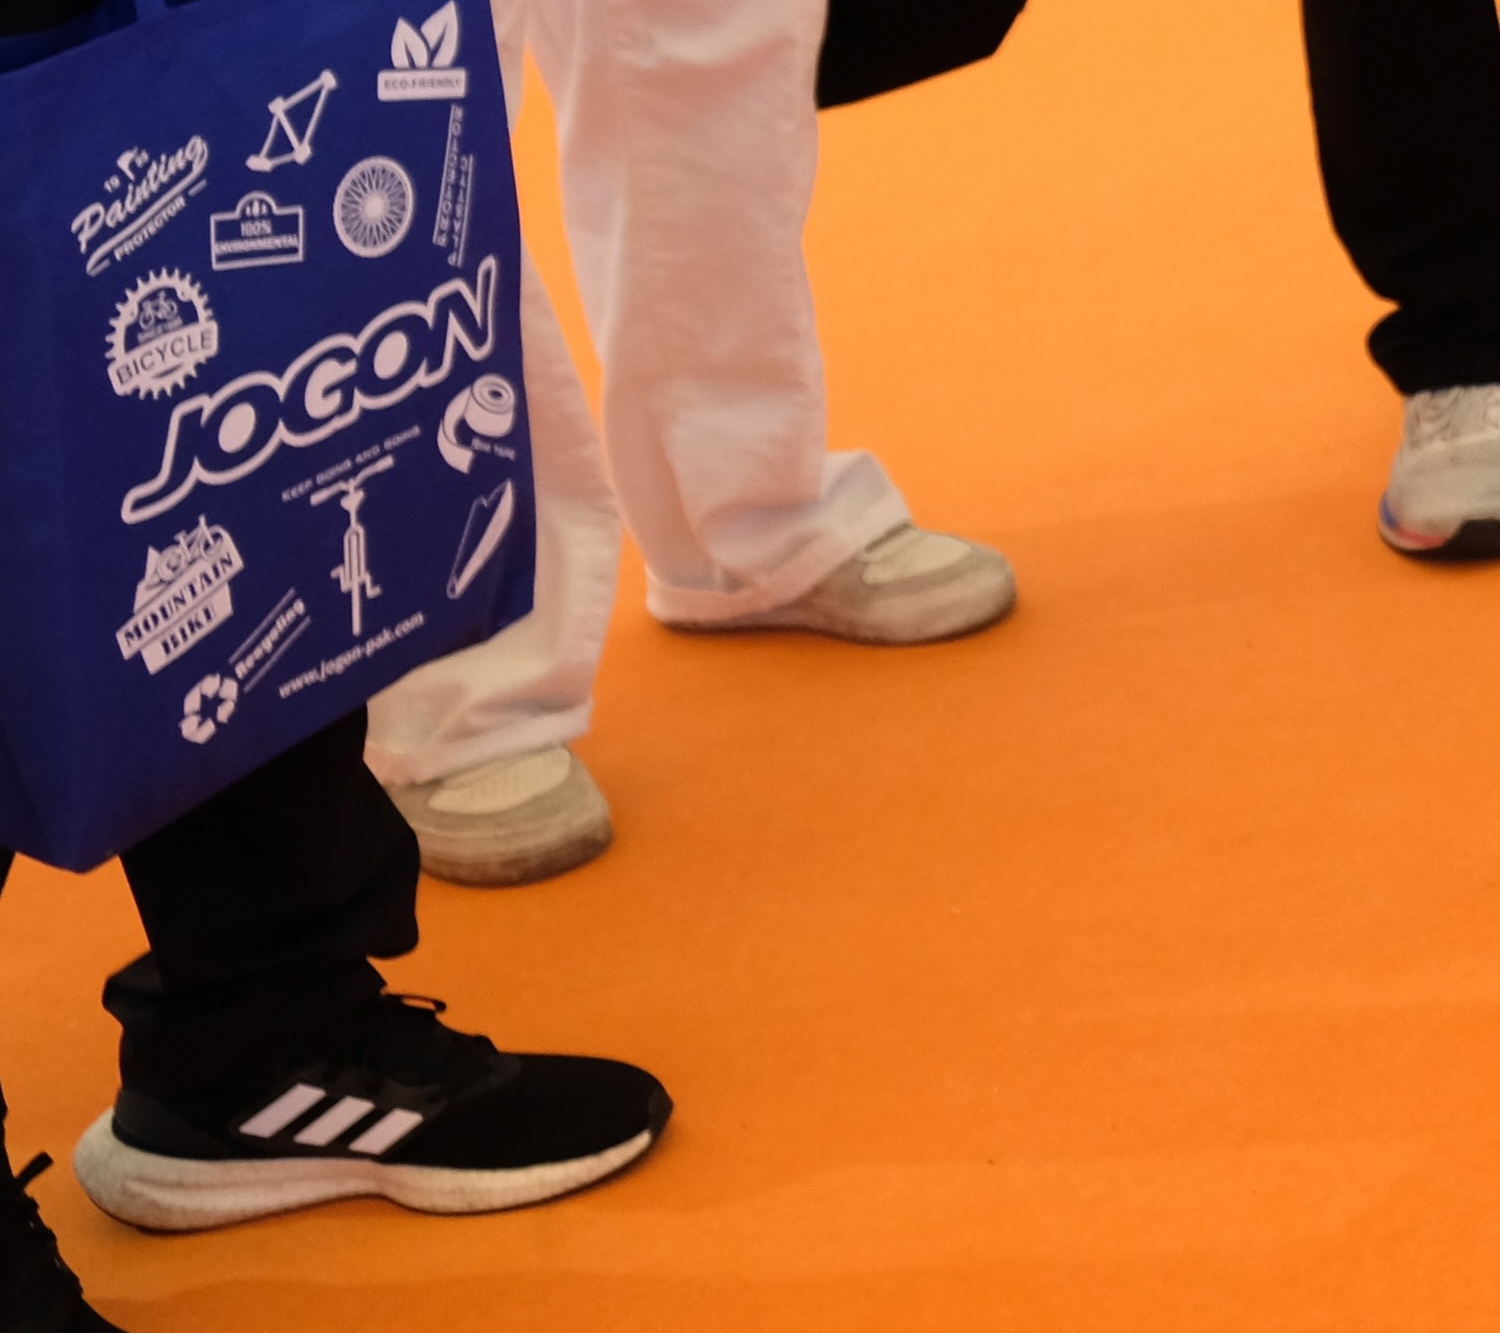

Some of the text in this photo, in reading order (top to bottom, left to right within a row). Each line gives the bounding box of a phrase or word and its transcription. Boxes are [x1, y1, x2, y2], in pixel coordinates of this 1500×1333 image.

[70, 134, 209, 255] Painting
[115, 328, 215, 386] BICYCLE
[120, 254, 498, 525] JOGON
[123, 553, 234, 648] MOUNTAIN
[160, 600, 218, 657] BIKE
